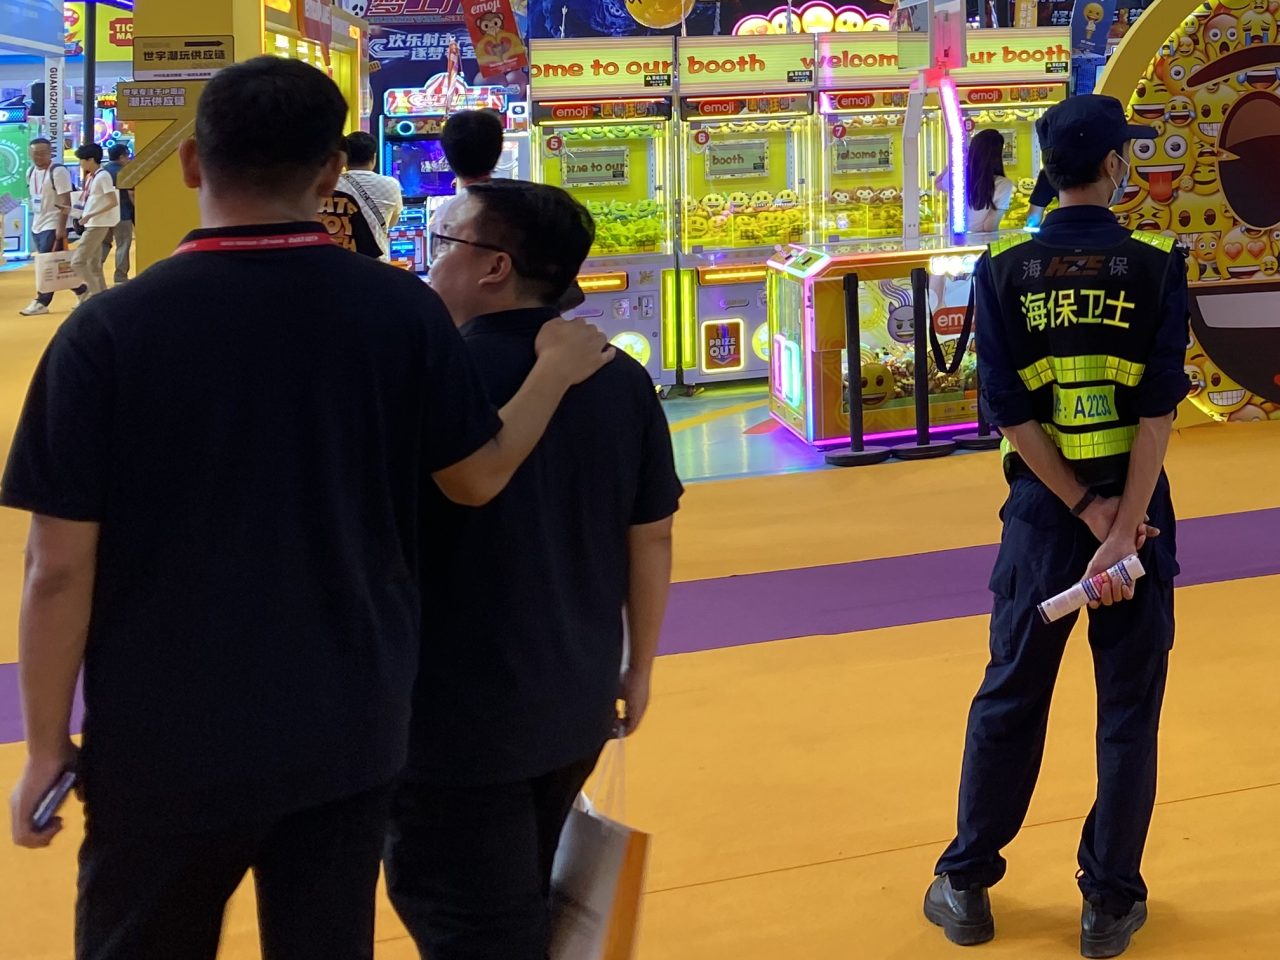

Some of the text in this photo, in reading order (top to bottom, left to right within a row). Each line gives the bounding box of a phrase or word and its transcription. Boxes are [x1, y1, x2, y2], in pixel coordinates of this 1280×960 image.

[410, 47, 477, 60] 逐梦宝
[801, 50, 898, 69] welcom
[967, 50, 996, 65] ur
[1002, 44, 1070, 64] booth
[591, 58, 620, 76] to
[626, 59, 676, 75] our
[687, 53, 765, 74] booth
[49, 67, 58, 120] GUANGZHOU
[970, 91, 999, 102] emoji
[840, 94, 871, 107] emoji
[556, 105, 589, 118] emoji
[703, 102, 735, 114] emoji
[836, 126, 843, 137] 7
[712, 153, 744, 164] booth
[1022, 258, 1042, 280] 海
[1109, 256, 1129, 277] 保
[1020, 289, 1136, 333] 海保卫士
[709, 337, 736, 346] PRIZE
[709, 345, 736, 357] OUT
